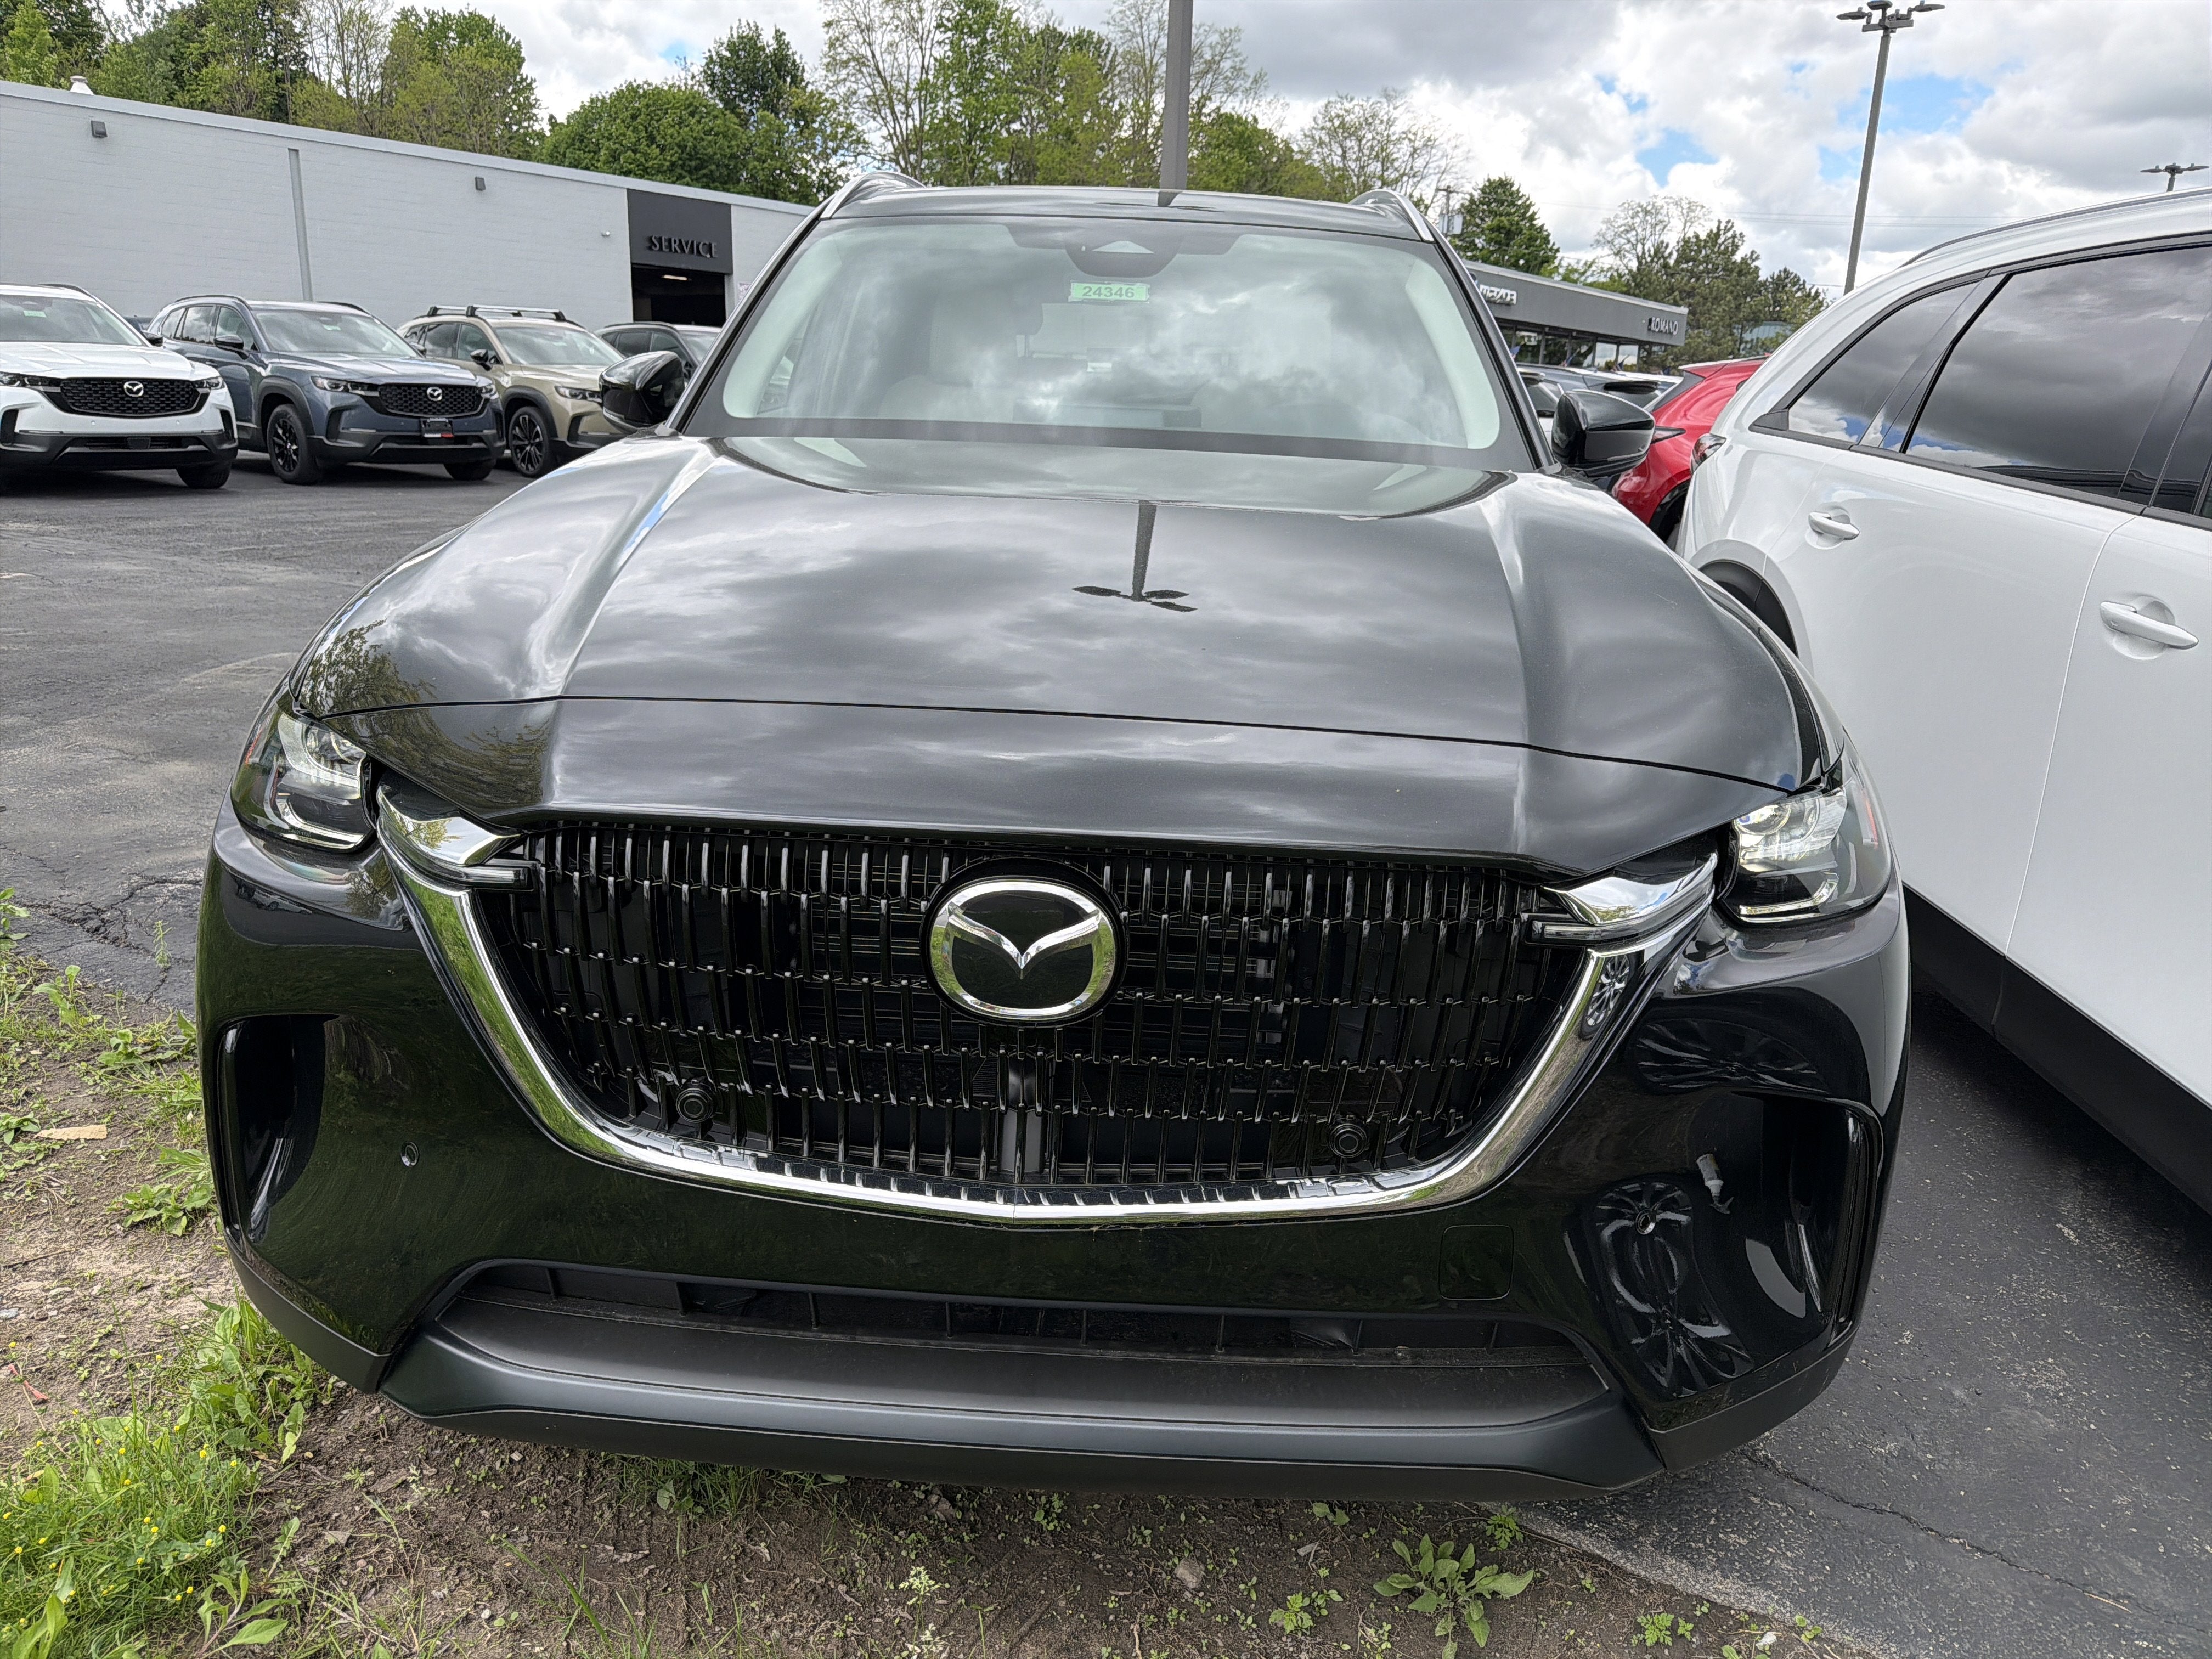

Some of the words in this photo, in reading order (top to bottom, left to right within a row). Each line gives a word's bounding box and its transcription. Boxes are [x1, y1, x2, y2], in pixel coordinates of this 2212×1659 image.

[651, 234, 718, 258] SERVICE
[1082, 286, 1135, 298] 24346
[1479, 284, 1517, 305] mazda
[1649, 317, 1679, 335] ROMANO
